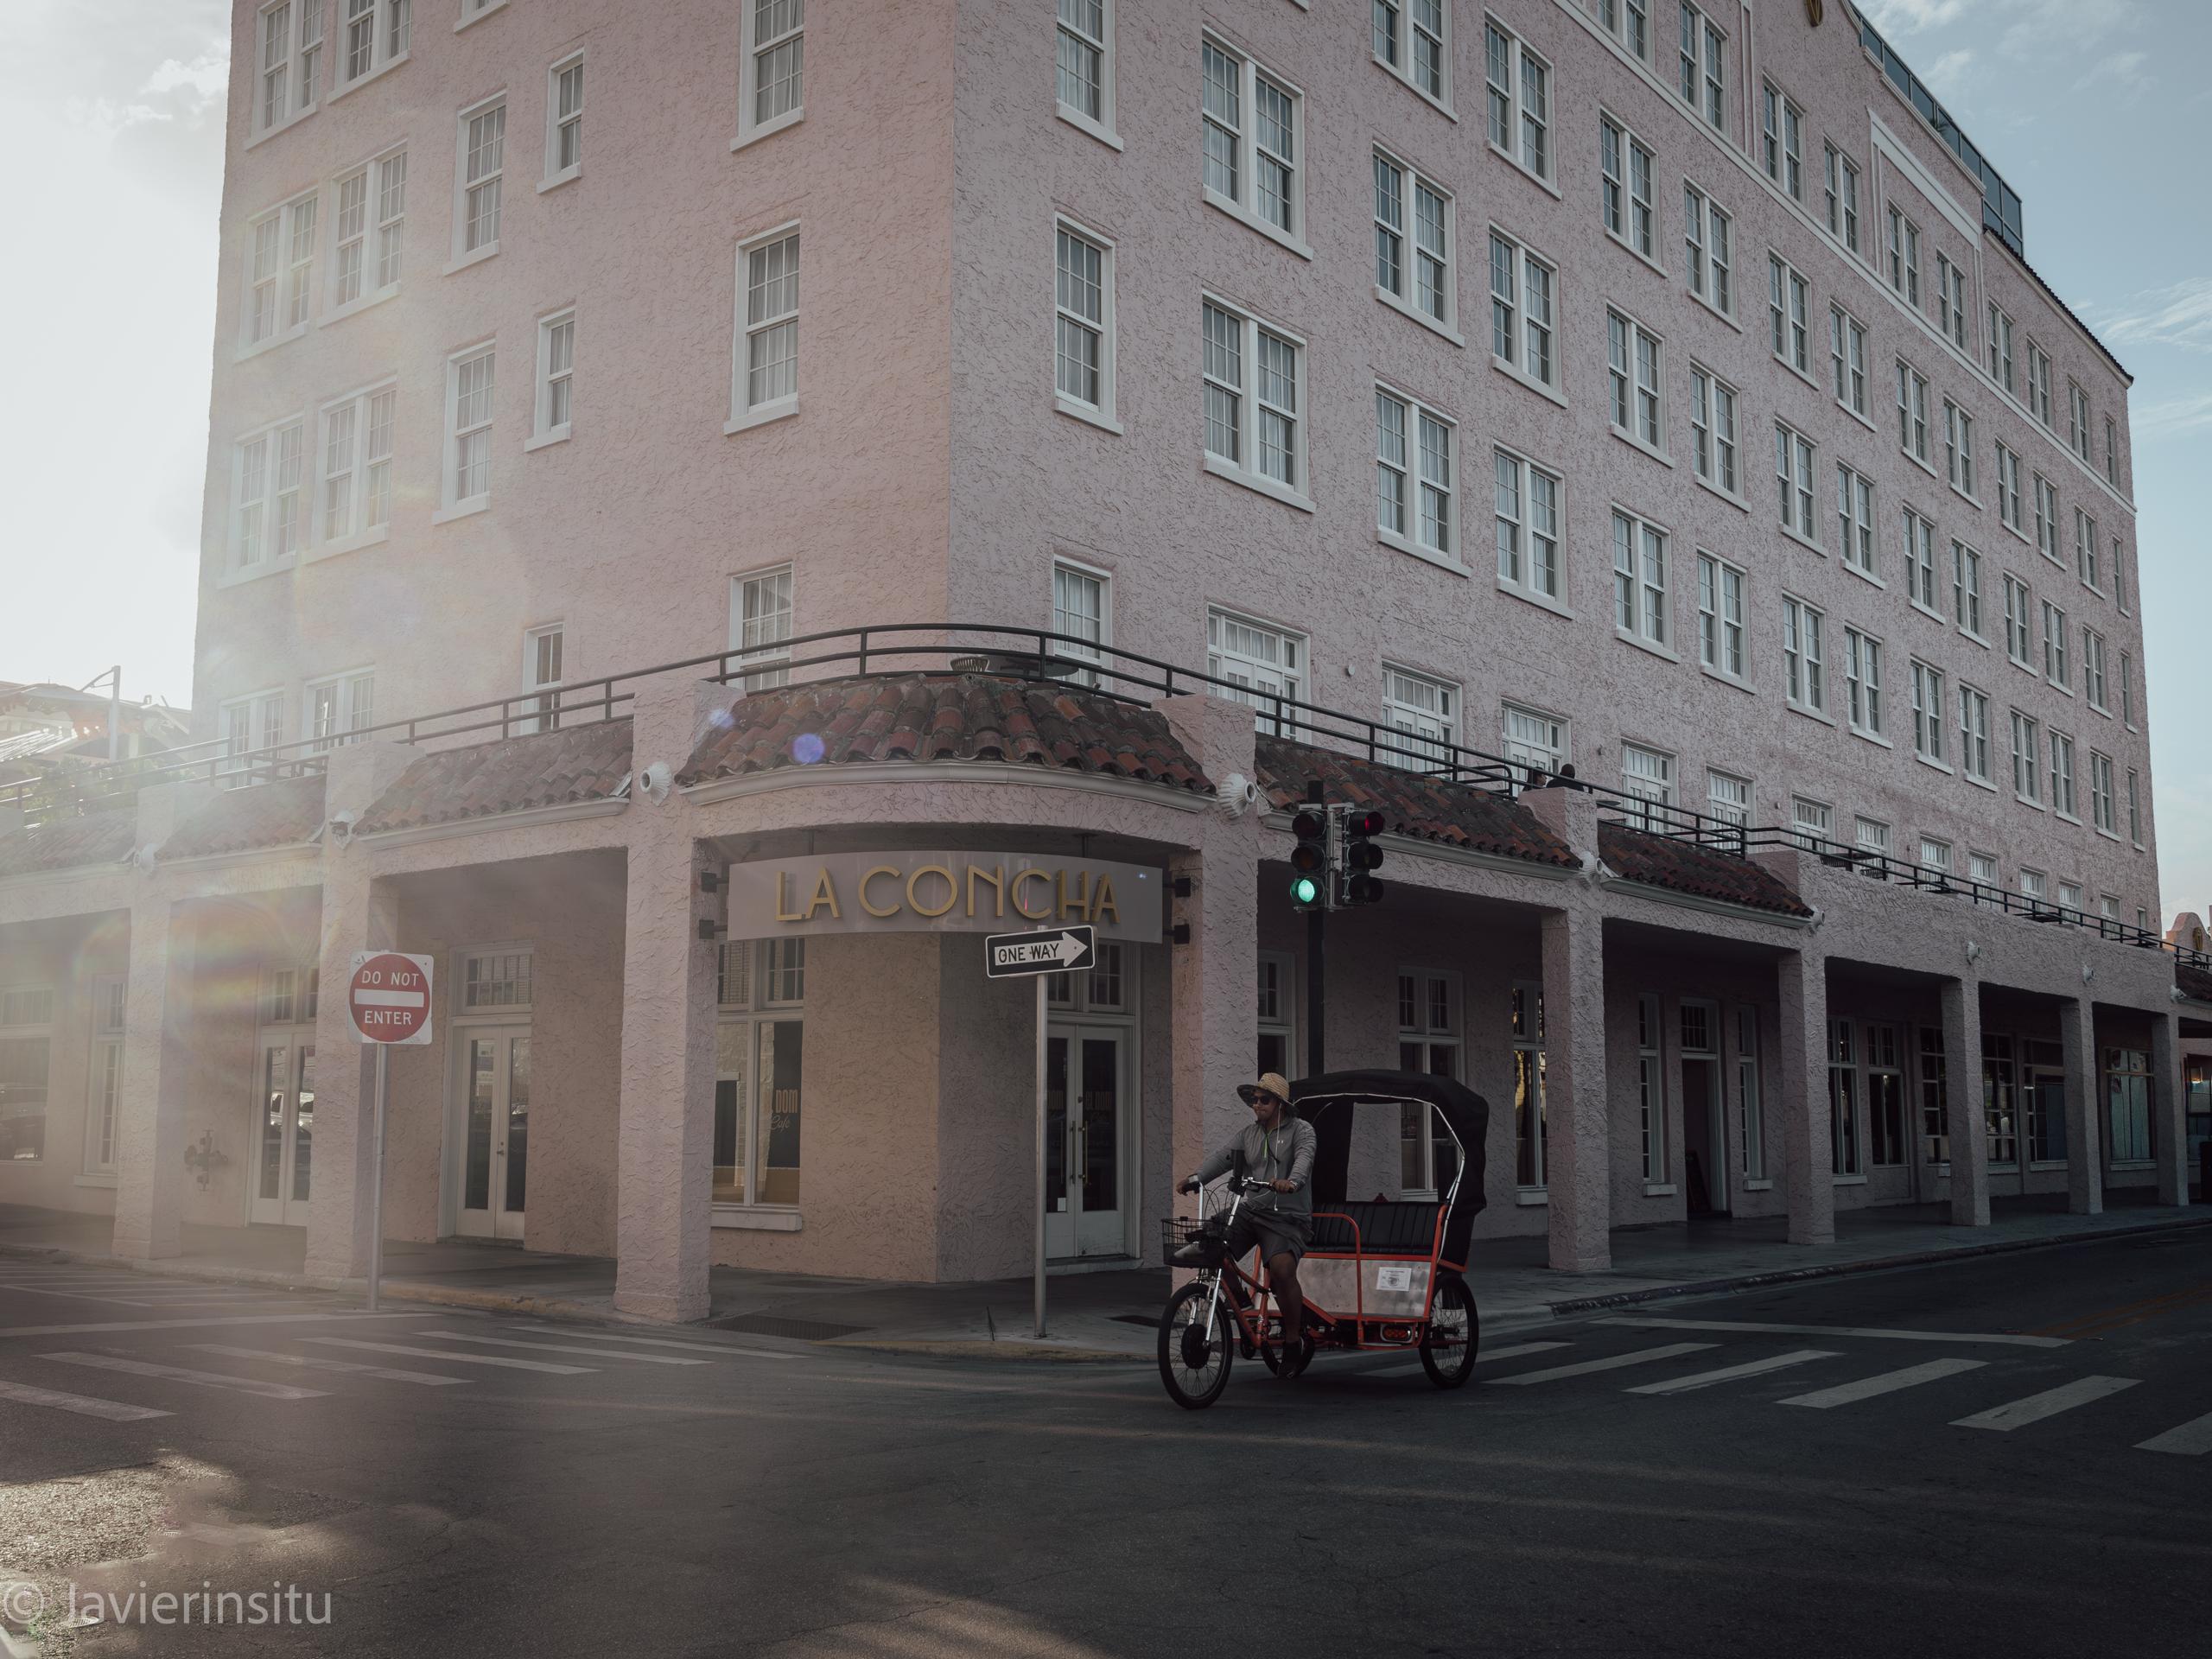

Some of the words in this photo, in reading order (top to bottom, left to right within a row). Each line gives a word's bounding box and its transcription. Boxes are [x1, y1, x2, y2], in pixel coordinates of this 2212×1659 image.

[777, 867, 842, 922] LA
[858, 865, 1121, 923] CONCHA
[998, 946, 1026, 963] ONE
[1030, 943, 1059, 960] WAY
[361, 970, 381, 984] DO
[391, 972, 419, 986] NOT
[365, 1010, 412, 1025] ENTER
